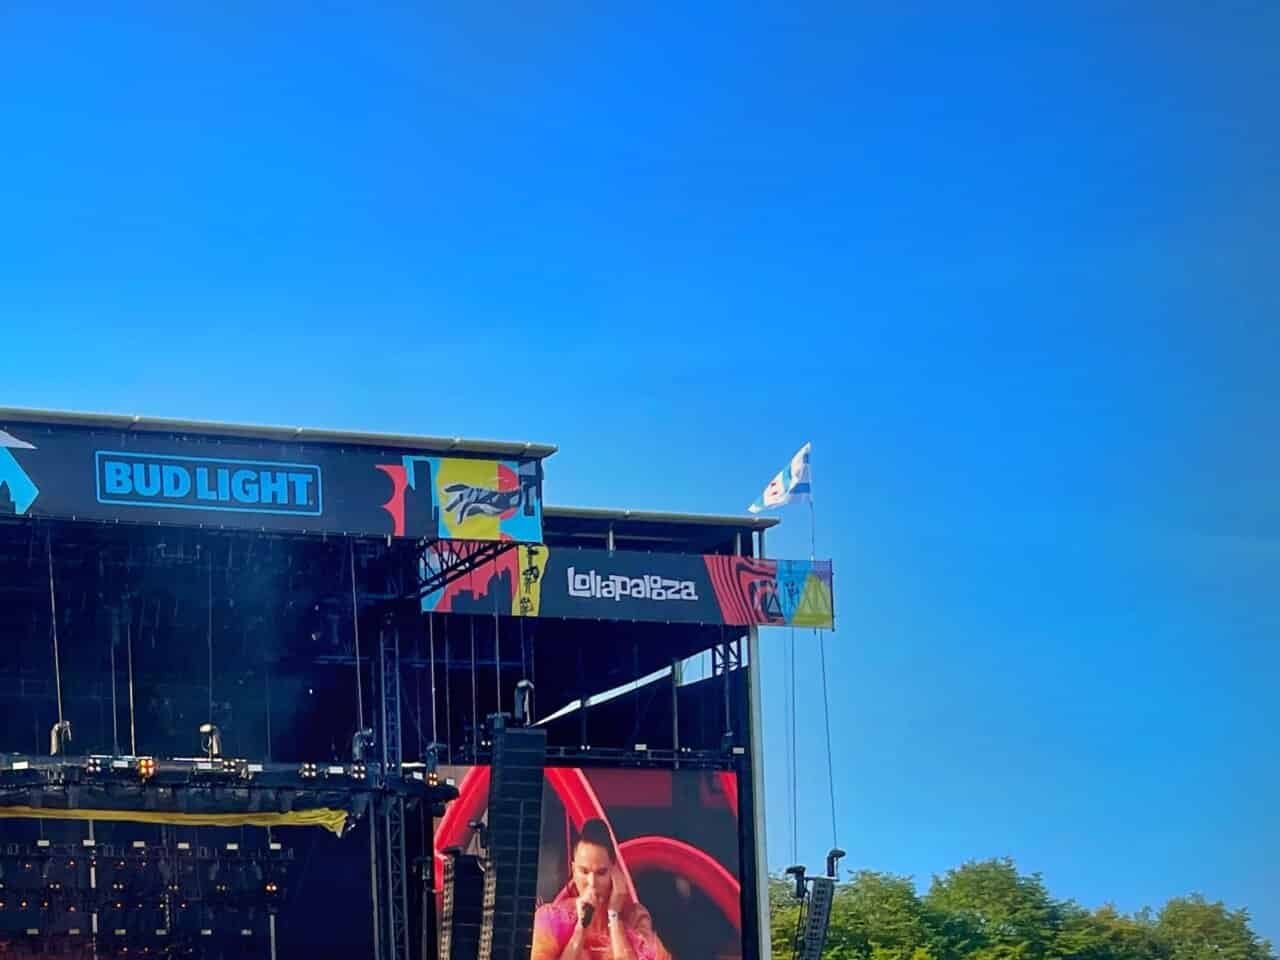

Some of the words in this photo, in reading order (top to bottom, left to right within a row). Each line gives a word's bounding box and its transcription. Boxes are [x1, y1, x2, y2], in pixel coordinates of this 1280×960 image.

[104, 461, 192, 498] BUD
[196, 466, 313, 505] LIGHT
[567, 566, 699, 601] Lollapalooza
